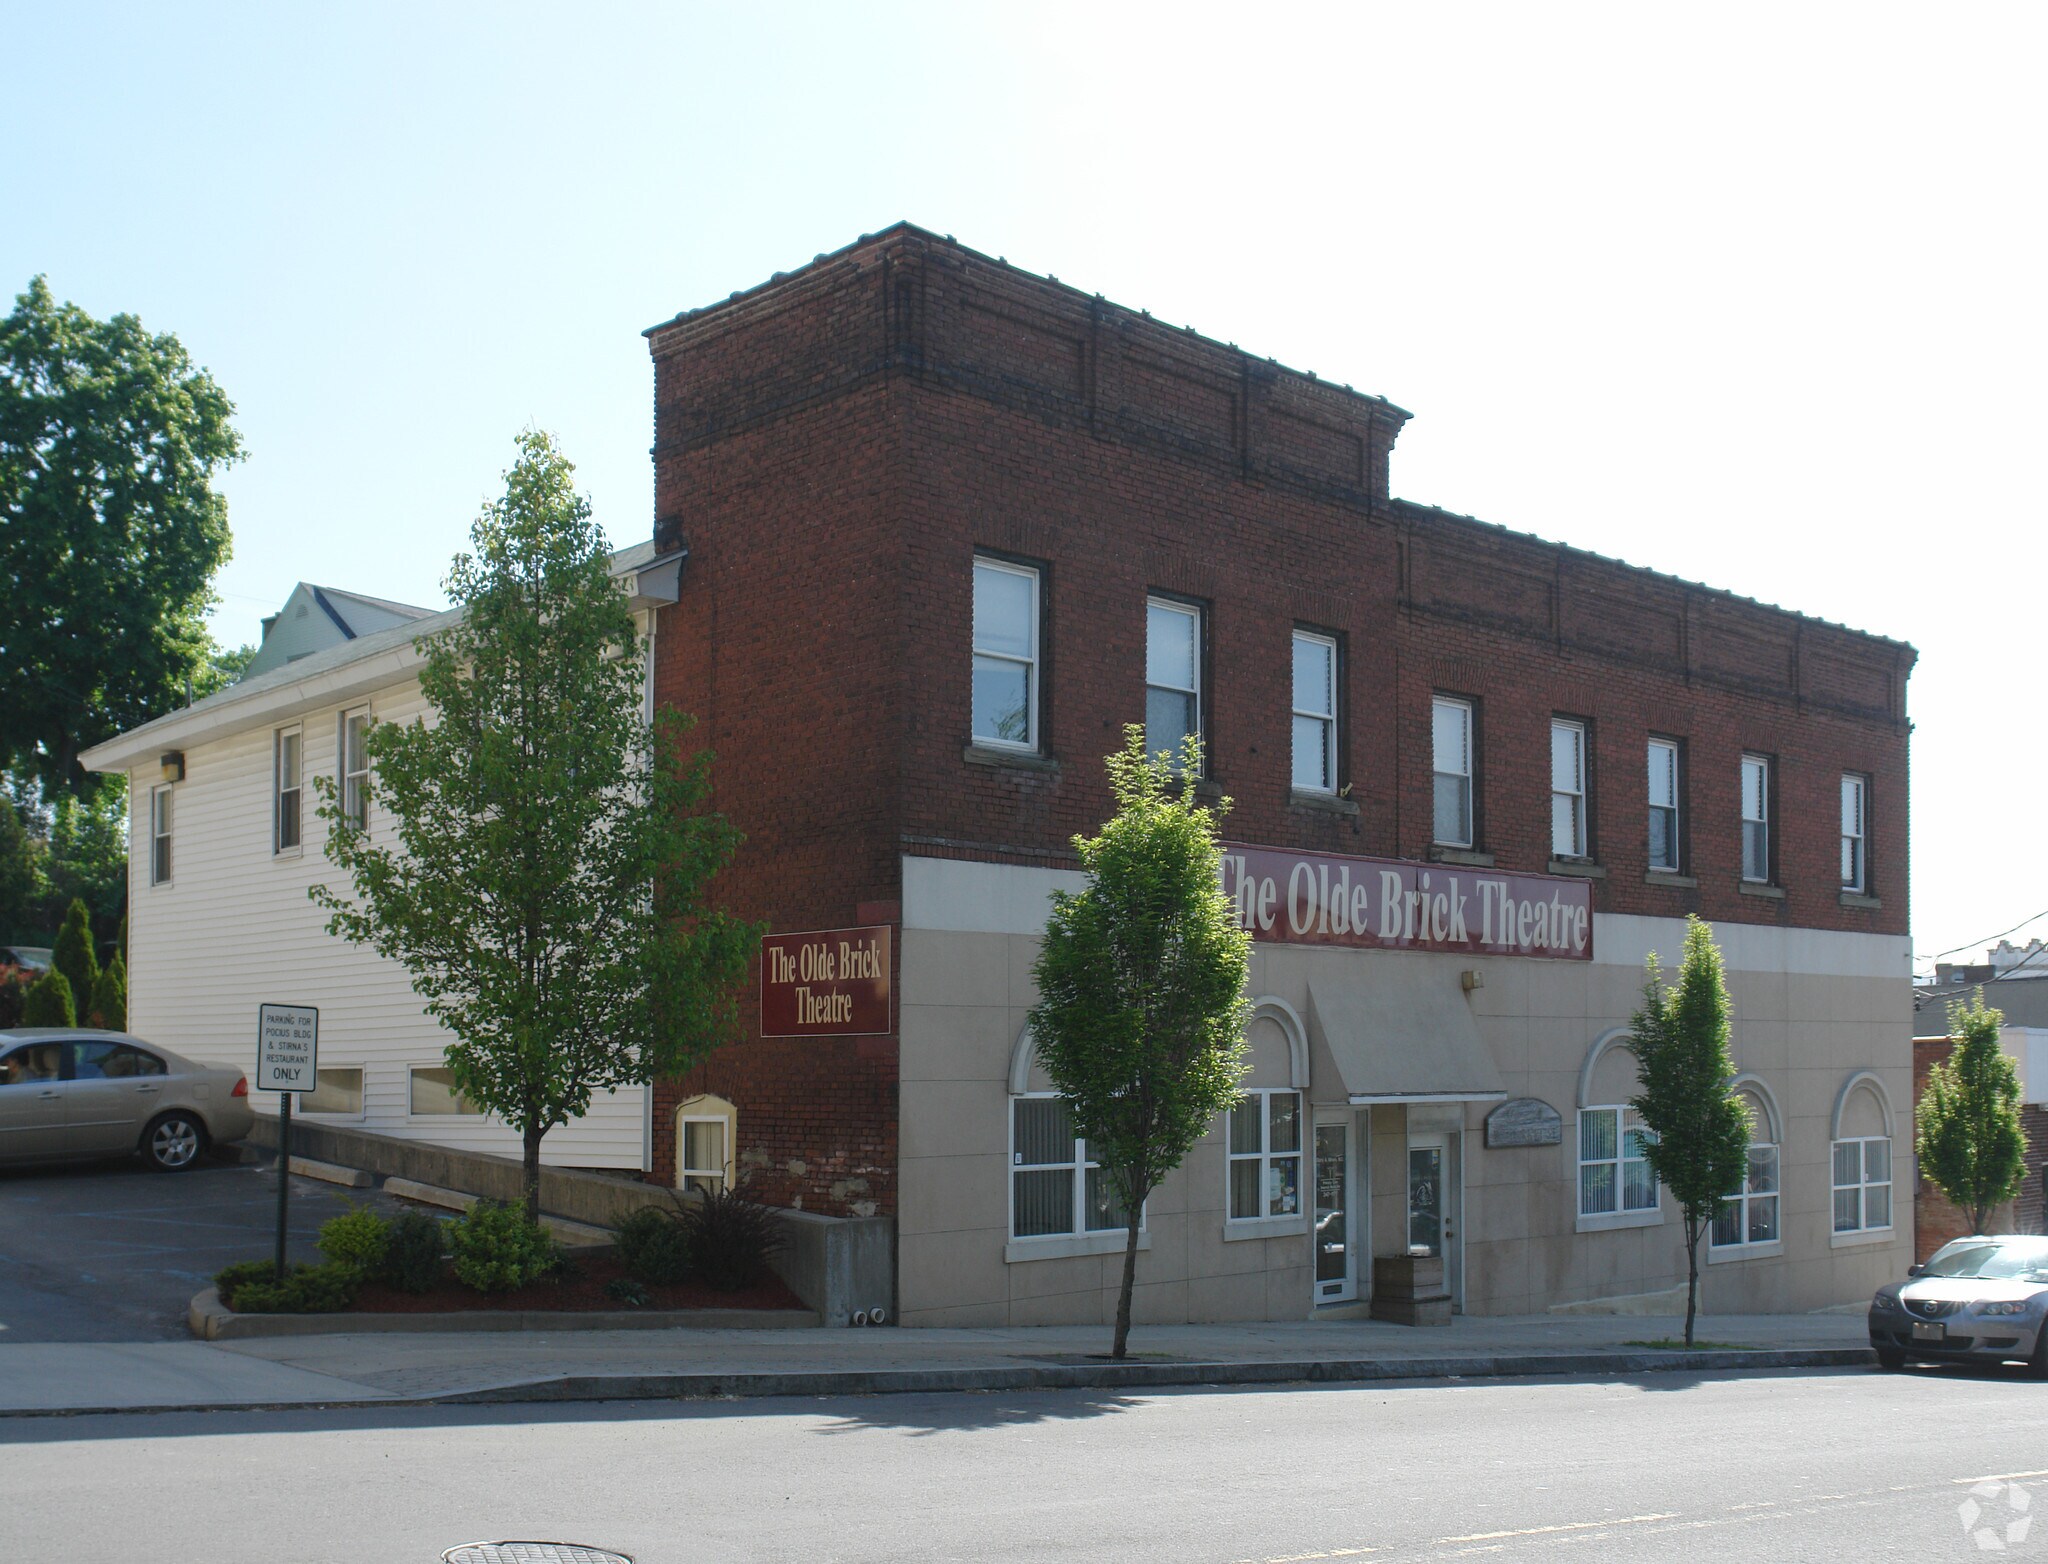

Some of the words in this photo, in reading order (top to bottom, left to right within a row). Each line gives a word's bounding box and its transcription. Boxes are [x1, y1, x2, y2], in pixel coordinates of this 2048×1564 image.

[1213, 853, 1277, 931] The
[1288, 861, 1368, 936] Olde
[1379, 871, 1468, 943] Brick
[1476, 880, 1588, 951] Theatre
[769, 946, 796, 984] The
[800, 943, 835, 982] Olde
[839, 939, 881, 980] Brick
[795, 986, 852, 1024] Theatre
[266, 1014, 295, 1025] PARKING
[298, 1017, 312, 1026] FOR
[293, 1029, 312, 1039] BLDG
[267, 1040, 274, 1050] &
[266, 1053, 309, 1064] RESTAURANT
[273, 1067, 301, 1080] ONLY
